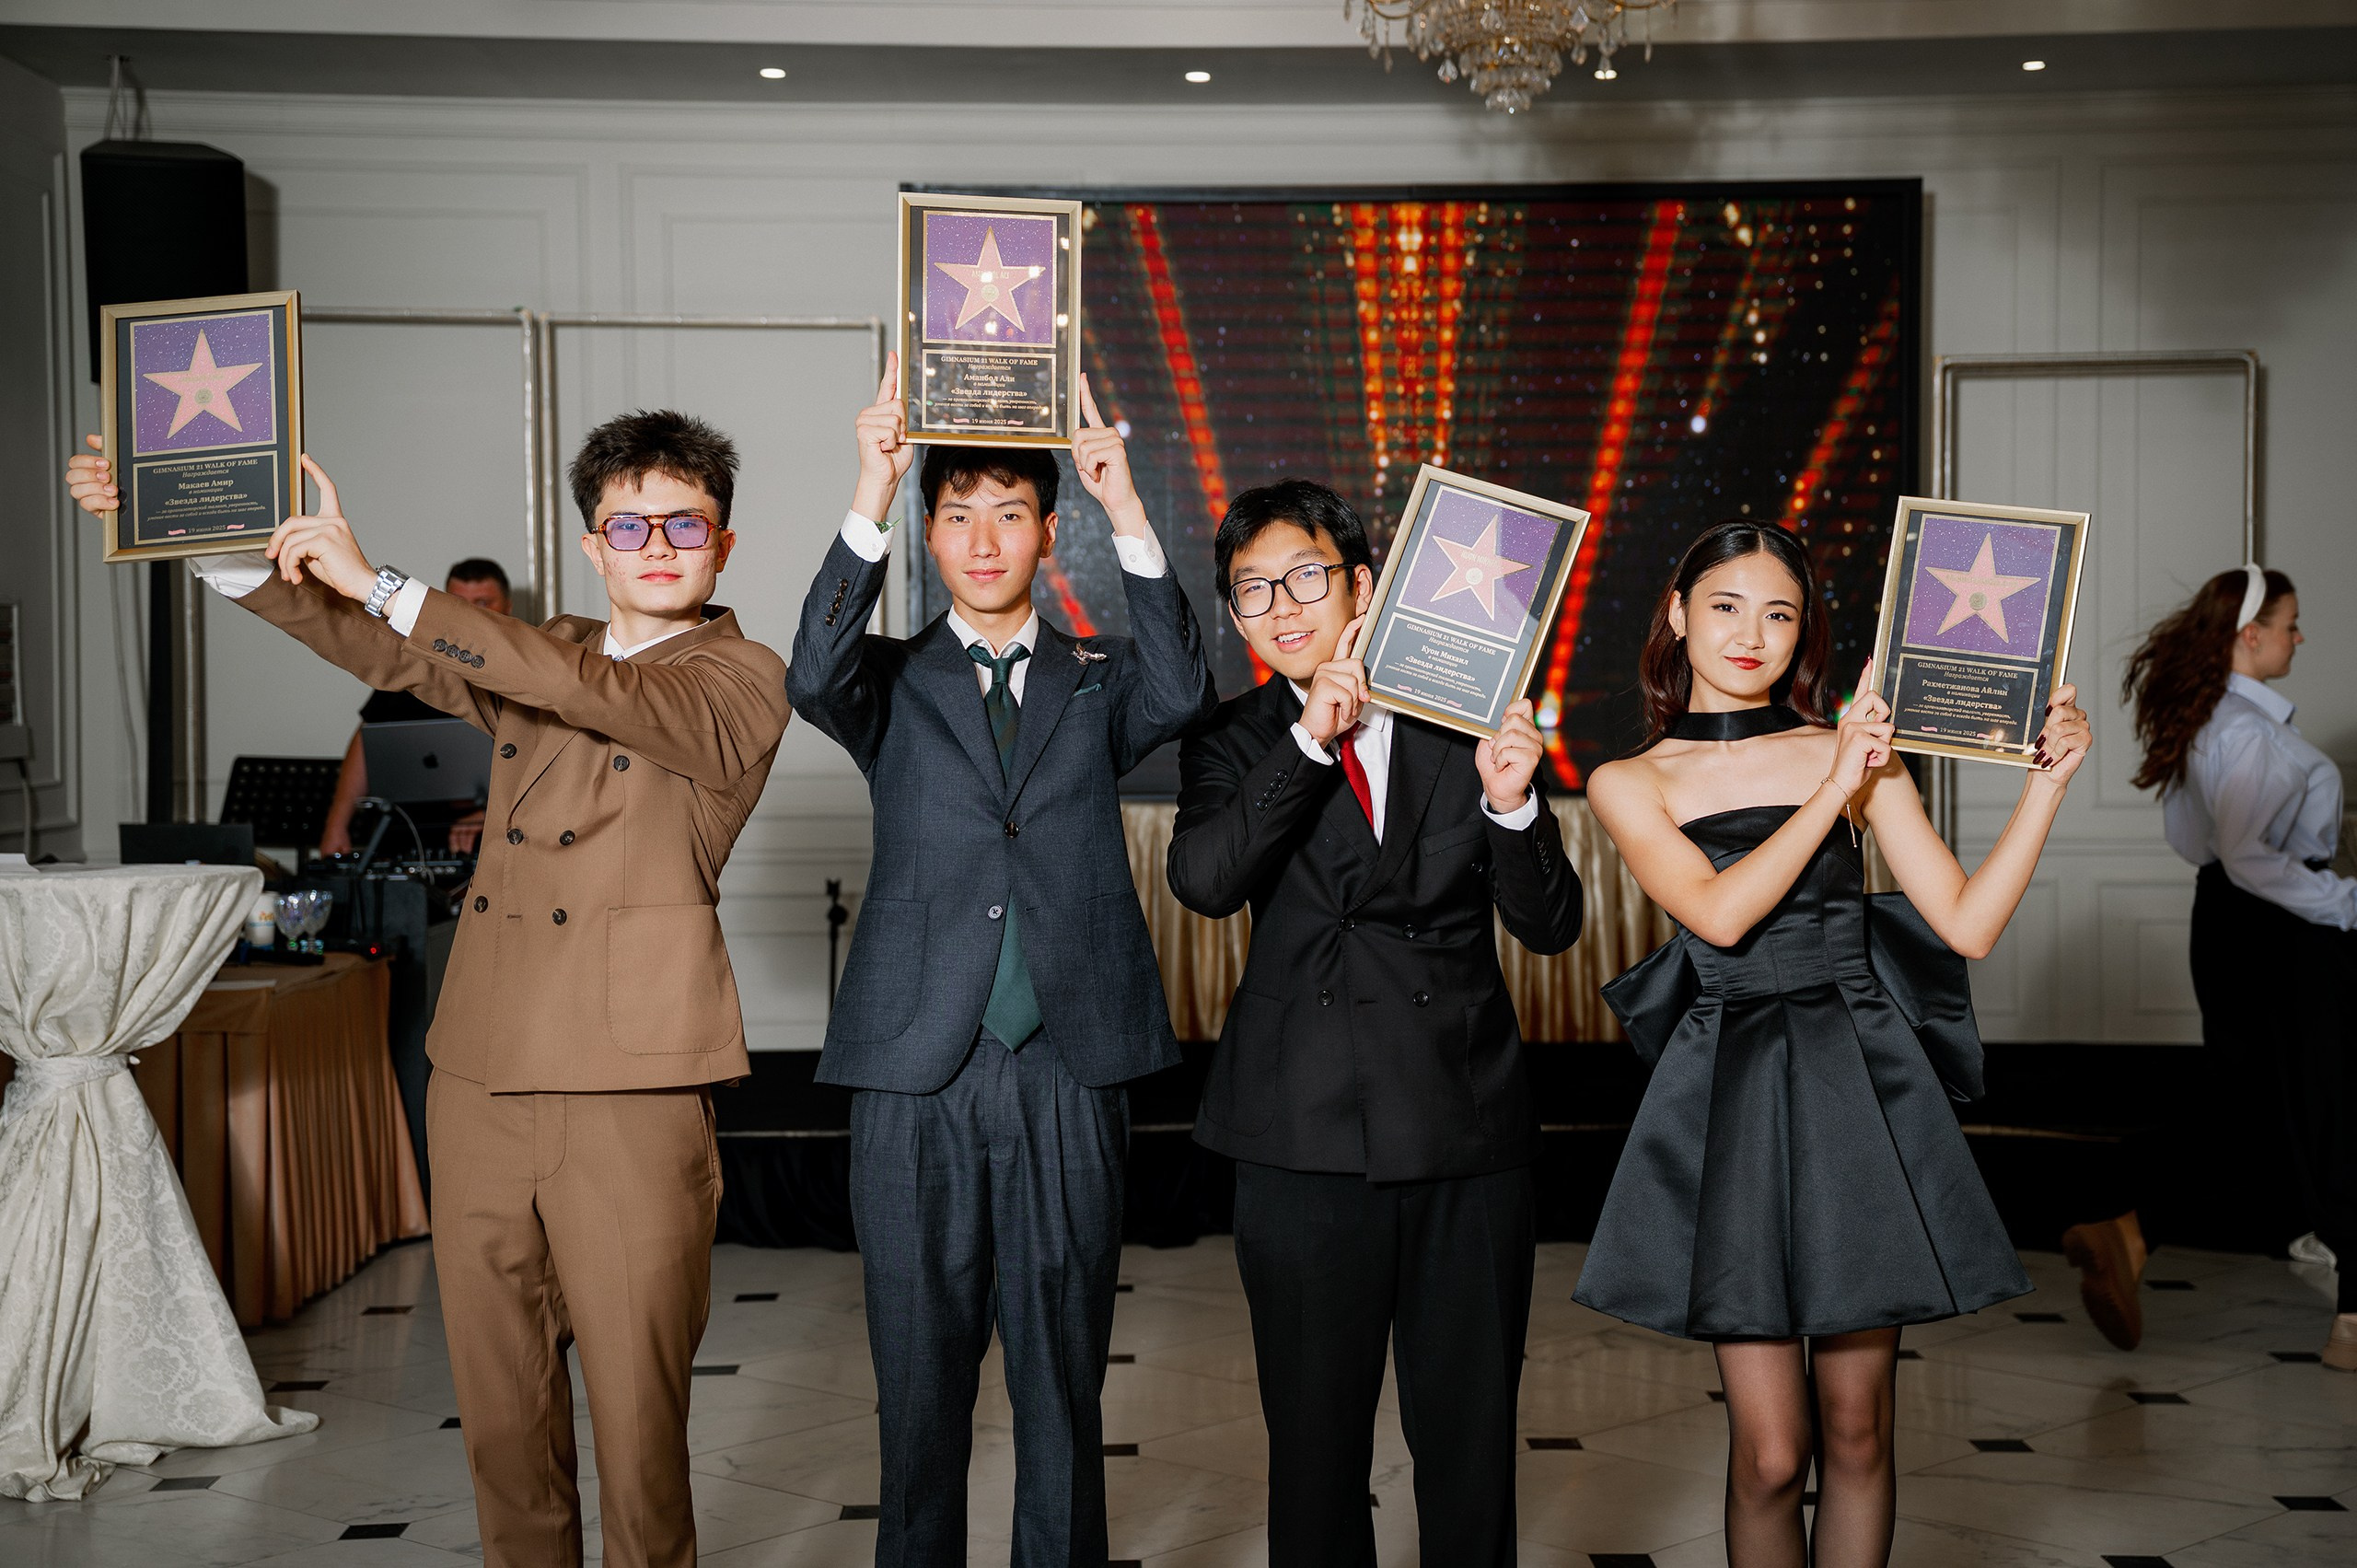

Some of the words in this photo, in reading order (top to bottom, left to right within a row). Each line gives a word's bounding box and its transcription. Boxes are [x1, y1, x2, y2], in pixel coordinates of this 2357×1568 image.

[964, 374, 998, 382] Аманбол
[951, 388, 981, 396] «Звезда
[983, 389, 1028, 398] лидерства»
[154, 465, 194, 474] GIMNASIUM
[238, 459, 258, 467] FAME
[179, 481, 209, 490] Макаев
[211, 479, 234, 488] Амир
[165, 497, 198, 506] «Звезда
[199, 493, 247, 504] лидерства»
[1406, 623, 1443, 639] GIMNASIUM
[1449, 636, 1469, 647] WALK
[1469, 642, 1478, 650] OF
[1478, 645, 1496, 656] FAME
[1421, 645, 1441, 657] Куон
[1440, 651, 1469, 666] Михаил
[1405, 655, 1434, 669] «Звезда
[1433, 664, 1476, 683] лидерства»
[1917, 662, 1957, 672] GIMNASIUM
[1966, 668, 1987, 676] WALK
[1998, 671, 2018, 679] FAME
[1922, 679, 1980, 693] Рахметжанова
[1980, 686, 2008, 696] Айлин
[1922, 694, 1955, 705] «Звезда
[1955, 698, 2003, 711] лидерства»
